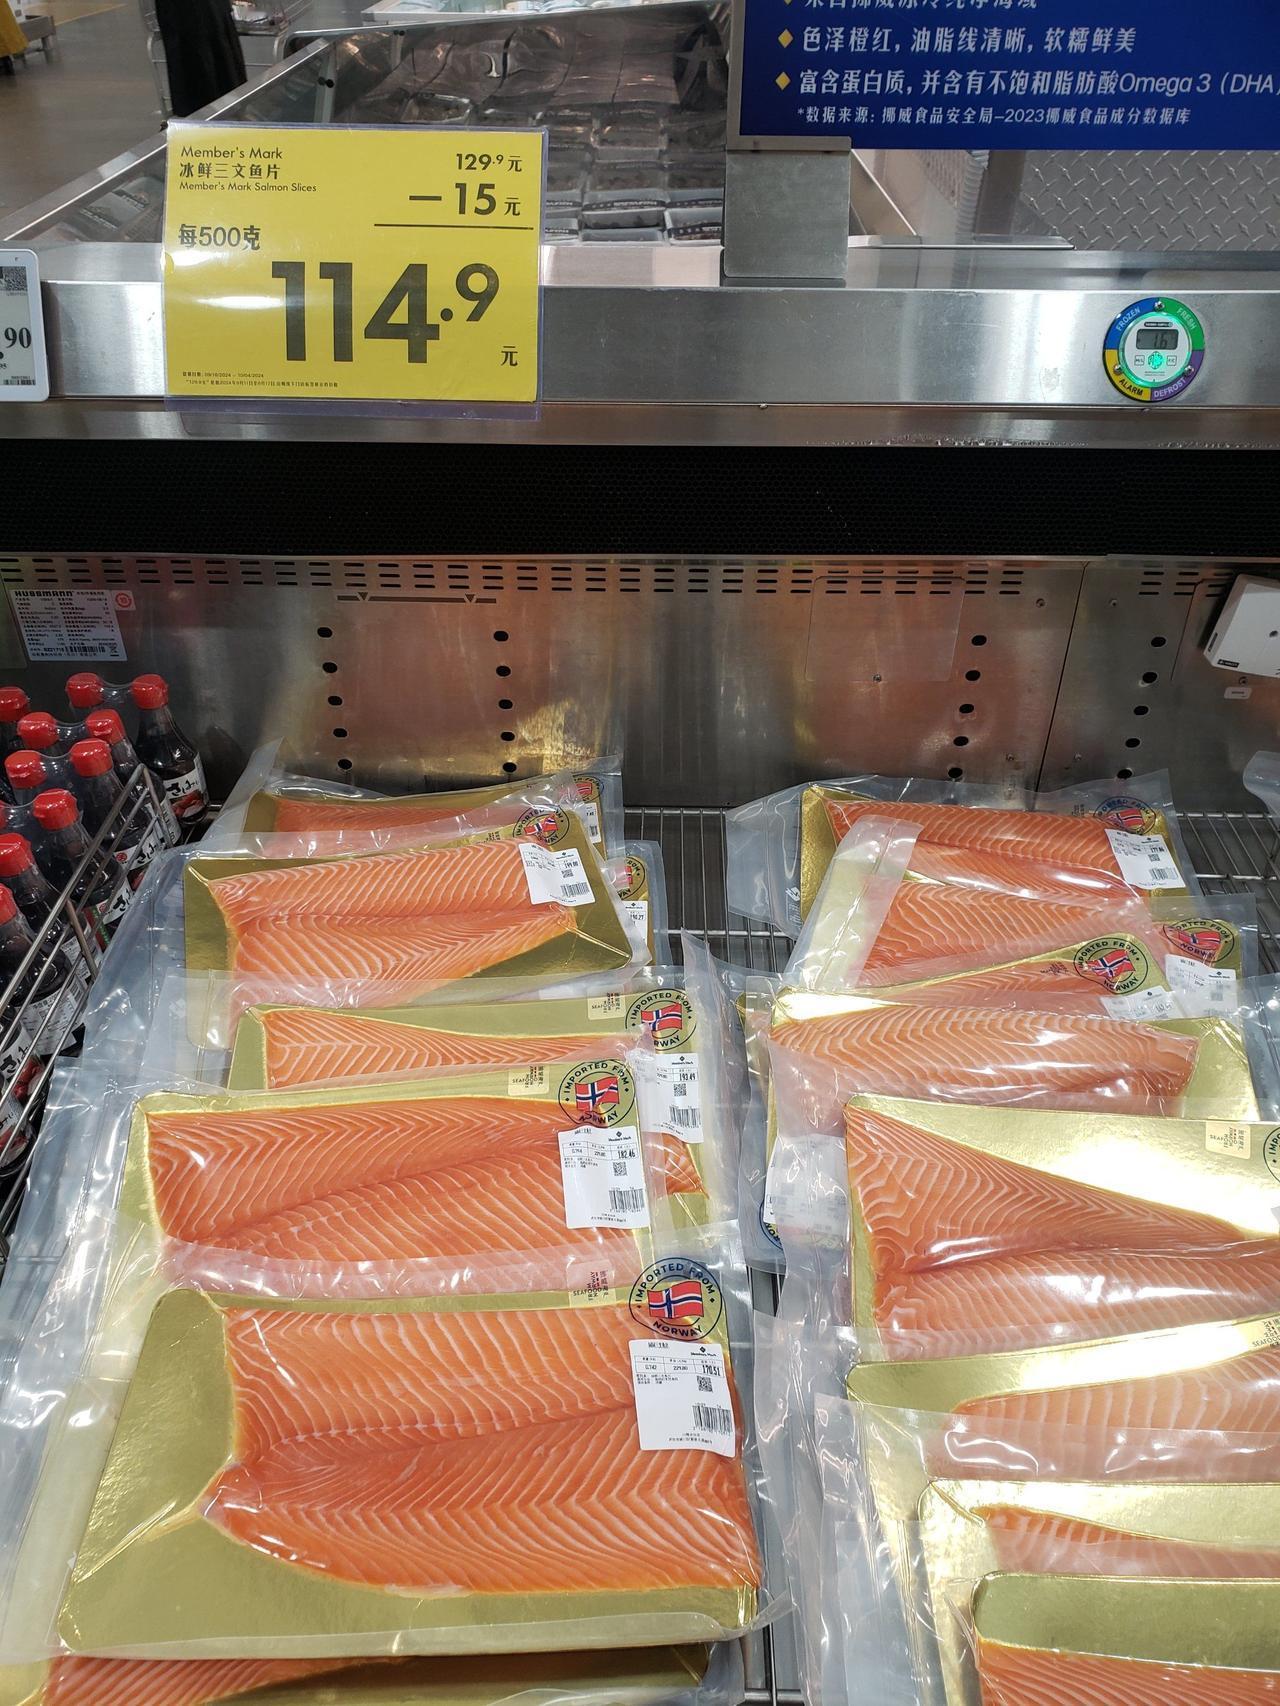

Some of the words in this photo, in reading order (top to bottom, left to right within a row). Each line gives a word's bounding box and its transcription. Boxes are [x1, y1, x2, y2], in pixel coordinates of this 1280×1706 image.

[803, 27, 1136, 53] 色泽橙红，油脂线清晰，软糯鲜美
[181, 146, 245, 159] Member's
[249, 147, 283, 160] Mark
[507, 155, 522, 172] 元
[179, 162, 281, 180] 冰鲜三文鱼片
[179, 182, 225, 191] Member's
[228, 183, 251, 191] Mark
[254, 184, 288, 192] Salmon
[291, 183, 317, 192] Slices
[504, 197, 521, 216] 元
[178, 223, 261, 250] 每500克
[271, 261, 500, 363] 114.9
[502, 346, 518, 366] 元
[1115, 307, 1141, 331] FROZEN
[1176, 308, 1198, 330] FRESH
[1119, 379, 1144, 396] ALARM
[1153, 376, 1187, 398] DEFROST
[631, 992, 672, 1020] IMPORTED
[563, 1063, 608, 1094] IMPORTED
[612, 1064, 630, 1087] FROM
[635, 1262, 684, 1302] IMPORTED
[689, 1267, 716, 1295] FROM
[652, 1320, 703, 1337] NORWAY
